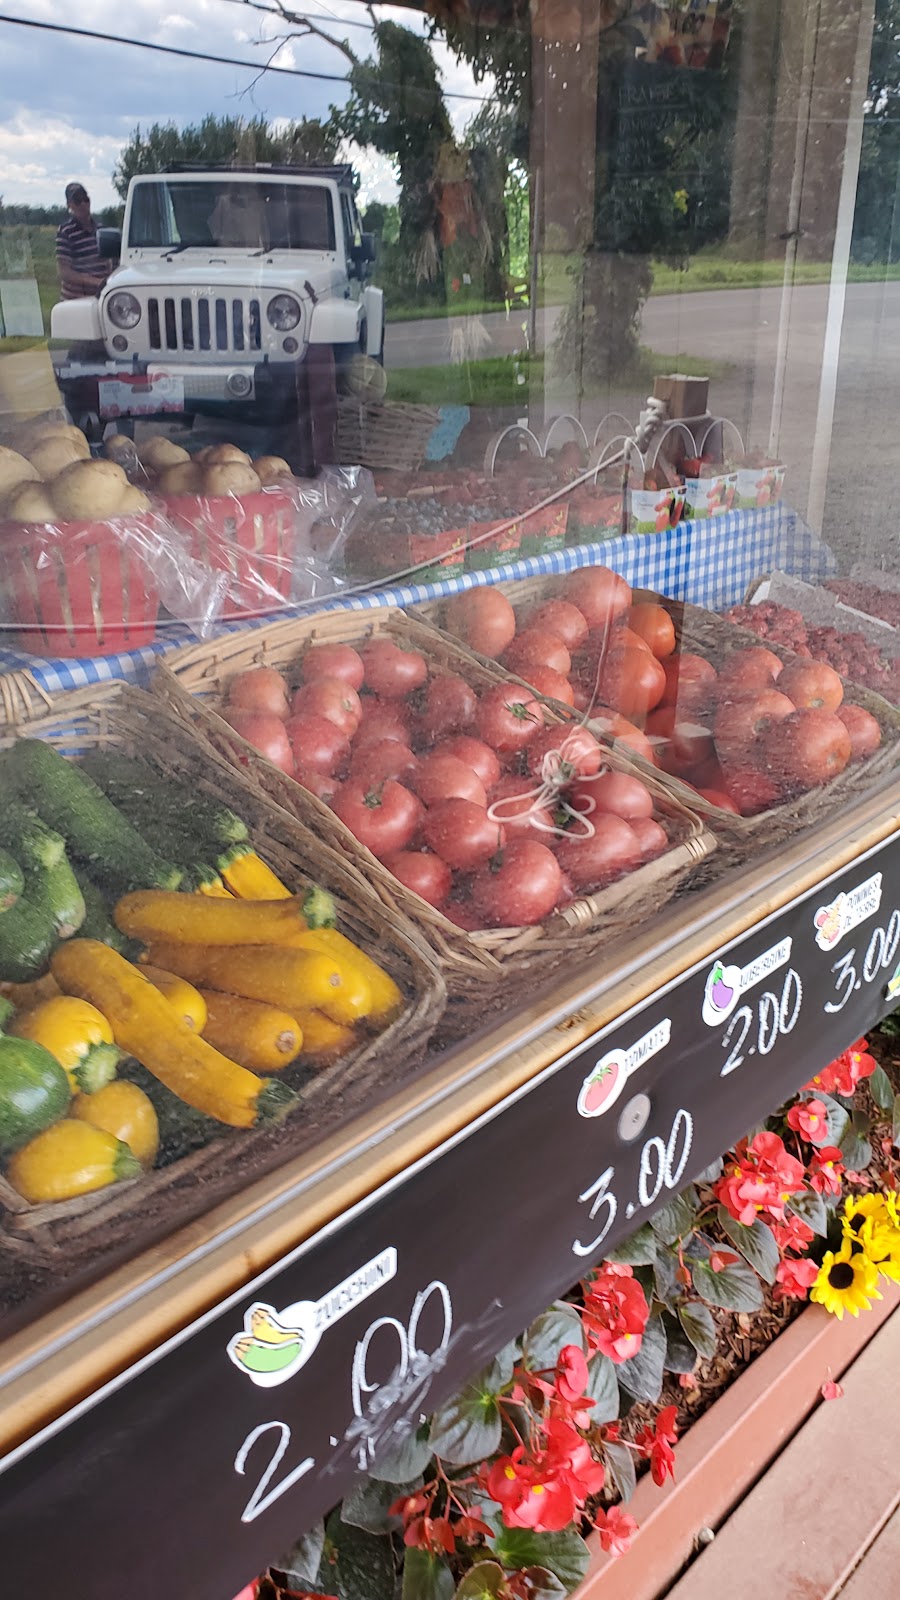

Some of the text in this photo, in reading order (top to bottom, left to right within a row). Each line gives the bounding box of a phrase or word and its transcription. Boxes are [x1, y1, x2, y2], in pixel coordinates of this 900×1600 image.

[824, 909, 900, 1013] 3.00
[720, 968, 803, 1077] 2.00
[572, 1109, 693, 1257] 3.00
[313, 1256, 391, 1329] ZUCCHINI
